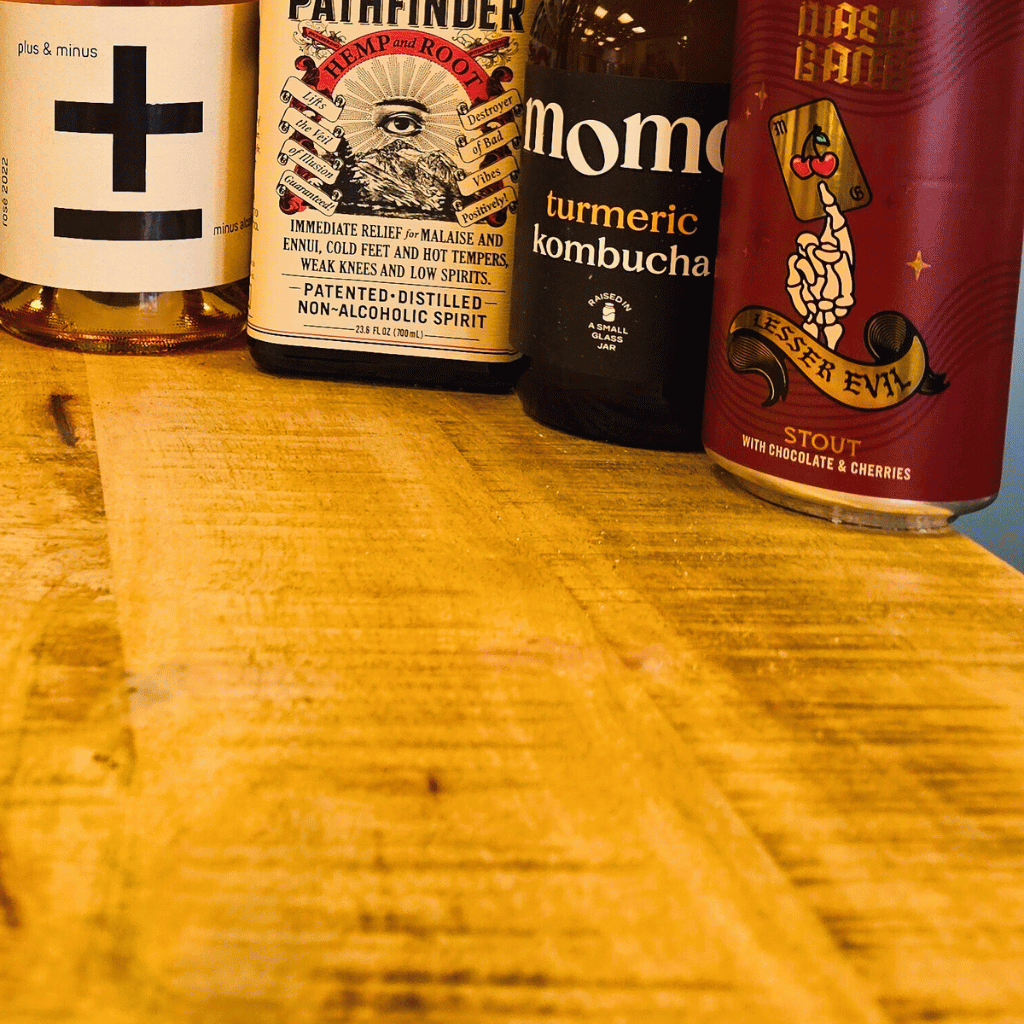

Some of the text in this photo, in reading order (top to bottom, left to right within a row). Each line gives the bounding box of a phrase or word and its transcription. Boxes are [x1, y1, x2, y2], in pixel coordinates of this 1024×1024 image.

[17, 41, 98, 59] plus & minus
[323, 35, 391, 79] HEMP
[392, 37, 416, 49] and
[419, 37, 484, 89] ROOT
[301, 90, 327, 111] Lifts
[467, 95, 514, 126] Destroyer
[294, 118, 335, 145] the Veil
[471, 132, 505, 156] of Bad
[288, 145, 335, 179] of Illusion
[472, 167, 502, 188] Vibes
[284, 175, 336, 212] Guaranteed!
[461, 191, 508, 224] Positively!
[546, 190, 698, 236] turmeric
[213, 222, 239, 236] minus
[290, 219, 504, 247] IMMEDIATE RELIEF for MALAISE AND
[283, 237, 509, 269] ENNUI, COLD FEET AND HOT TEMPERS,
[532, 223, 711, 277] kombucha
[301, 257, 492, 286] WEAK KNEES AND LOW SPIRITS.
[587, 292, 633, 312] RAISED IN
[355, 324, 370, 334] 23.6
[372, 326, 381, 336] FL
[382, 327, 391, 336] OZ
[433, 311, 488, 329] SPIRIT
[588, 321, 629, 335] A SMALL
[591, 331, 624, 343] GLASS
[597, 342, 616, 352] JAR
[753, 313, 913, 399] LESSER EVIL
[784, 426, 862, 457] STOUT
[742, 434, 912, 481] WITH CHOCOLATE & CHERRIES
